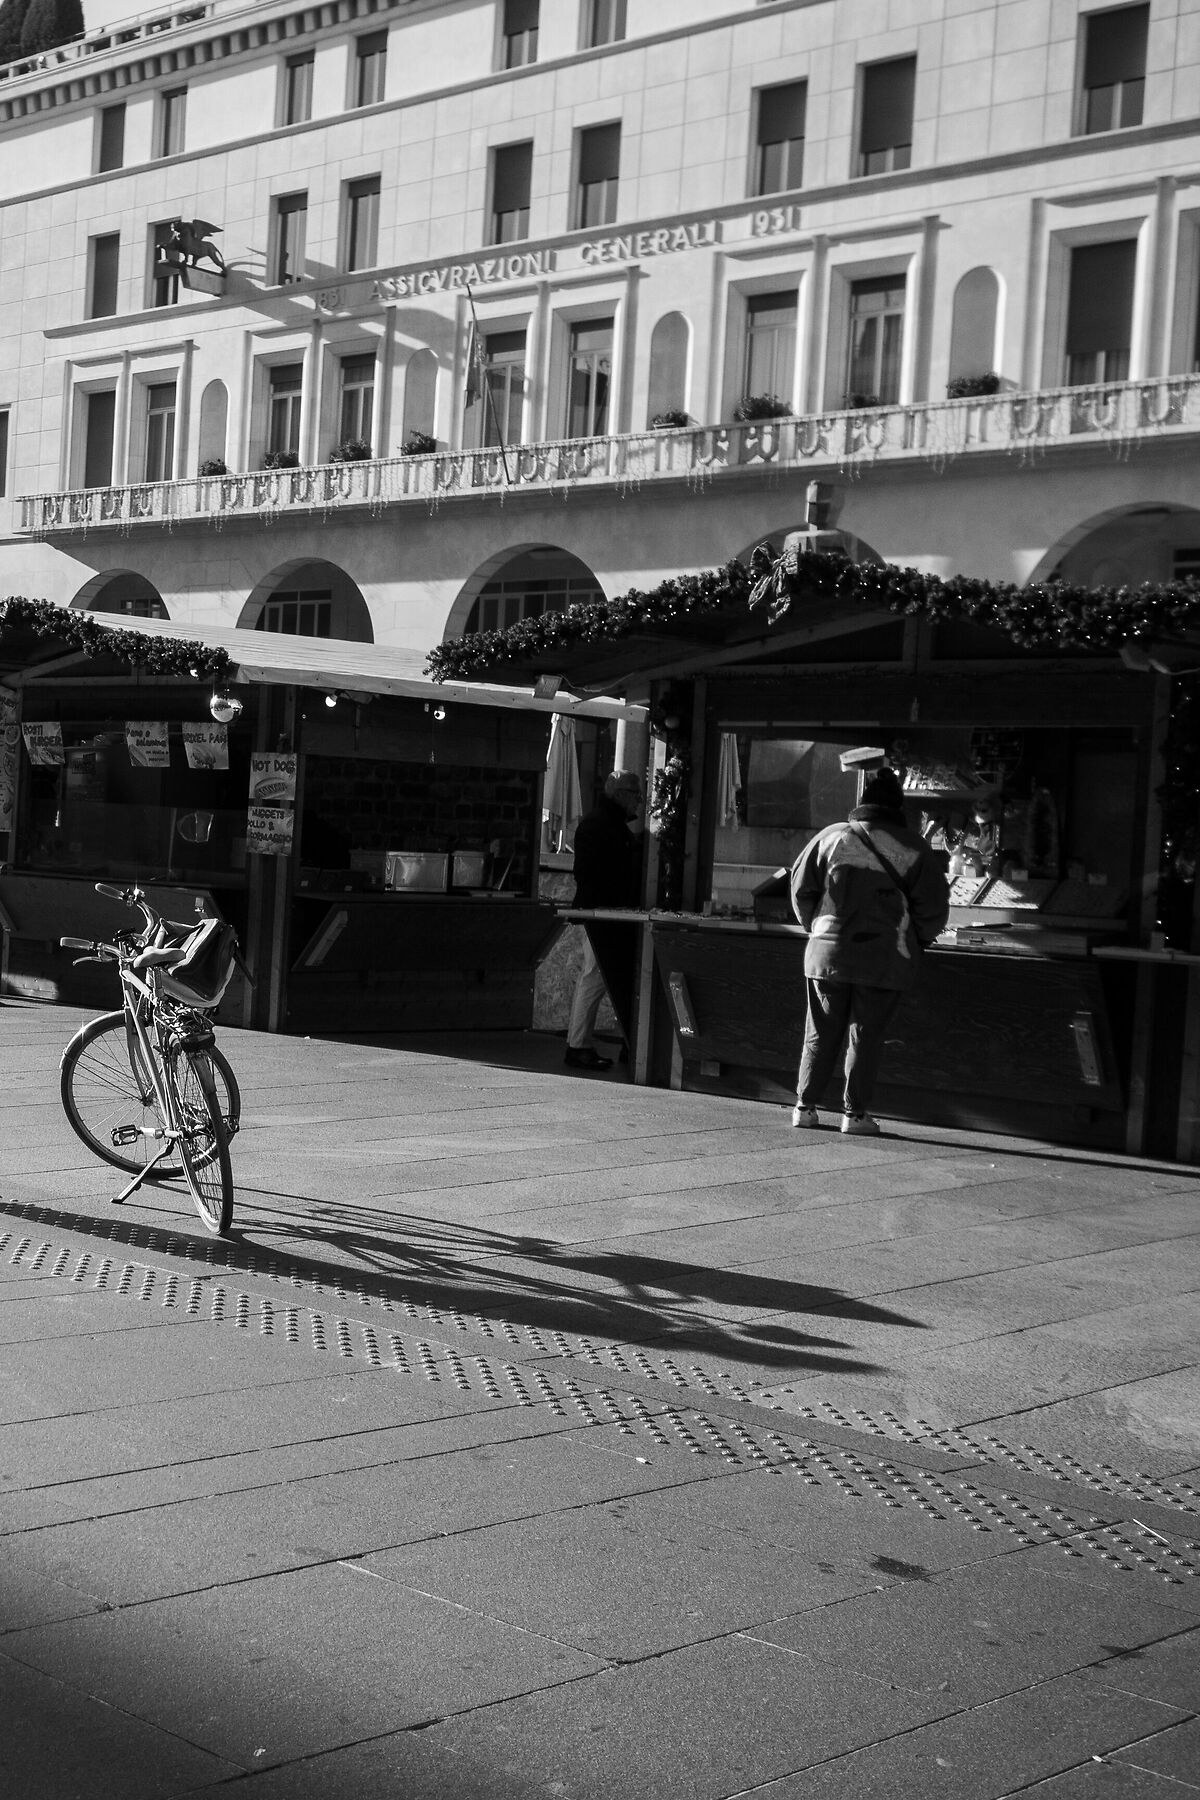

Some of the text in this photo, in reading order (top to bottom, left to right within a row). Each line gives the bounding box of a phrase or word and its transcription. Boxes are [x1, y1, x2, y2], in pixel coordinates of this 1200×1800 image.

[579, 219, 720, 264] GENERALI
[252, 759, 295, 774] HOT DOG
[251, 808, 285, 820] NUGGETS
